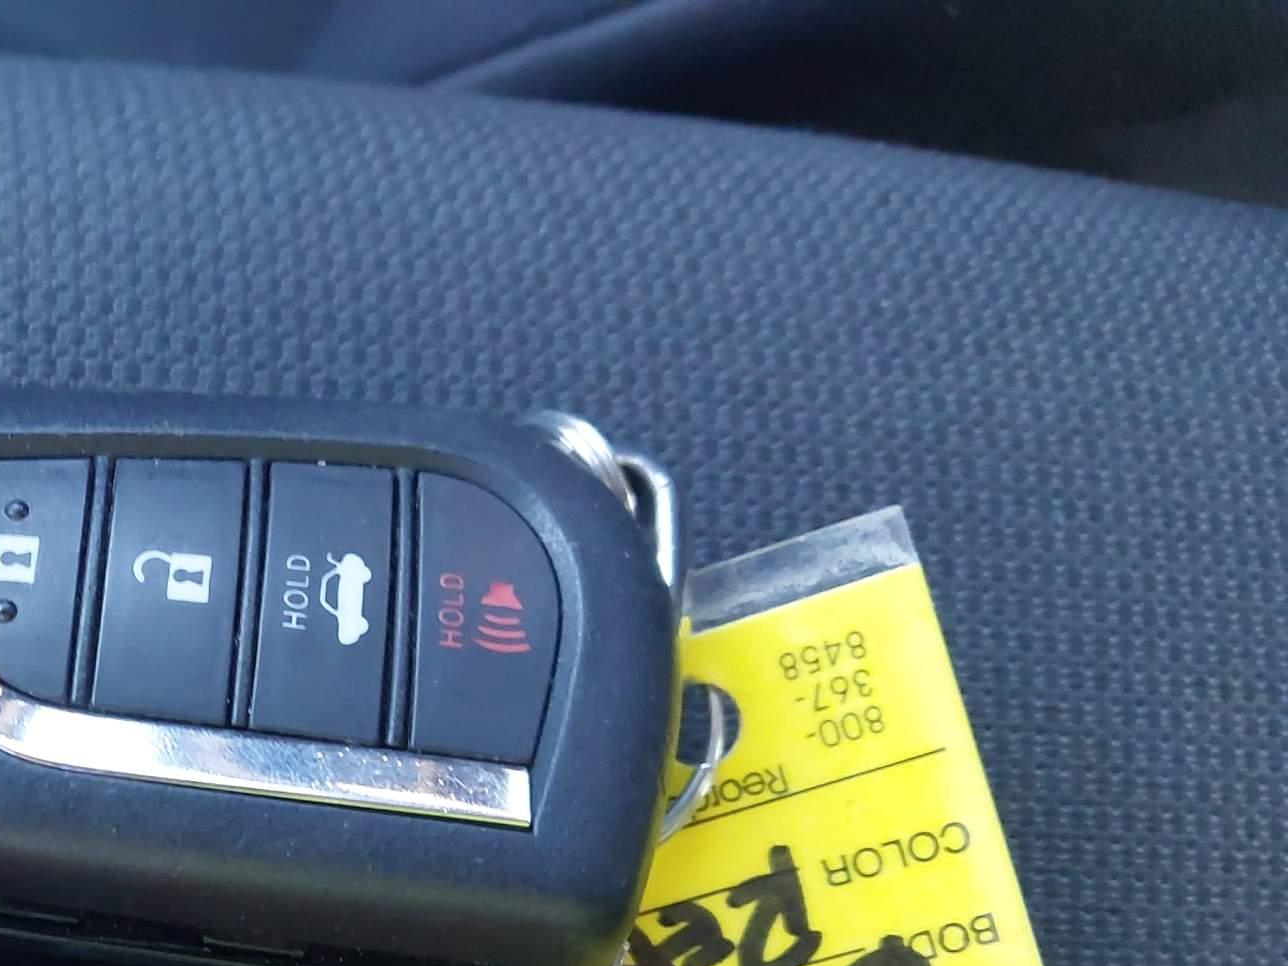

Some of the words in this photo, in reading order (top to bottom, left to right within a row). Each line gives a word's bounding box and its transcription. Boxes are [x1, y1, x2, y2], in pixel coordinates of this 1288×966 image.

[282, 554, 311, 631] HOLD
[439, 572, 465, 649] HOLD
[778, 631, 866, 681] 8458
[796, 669, 873, 711] 367-
[805, 706, 886, 748] 800-
[822, 821, 970, 887] COLOR
[907, 912, 1001, 961] BOD
